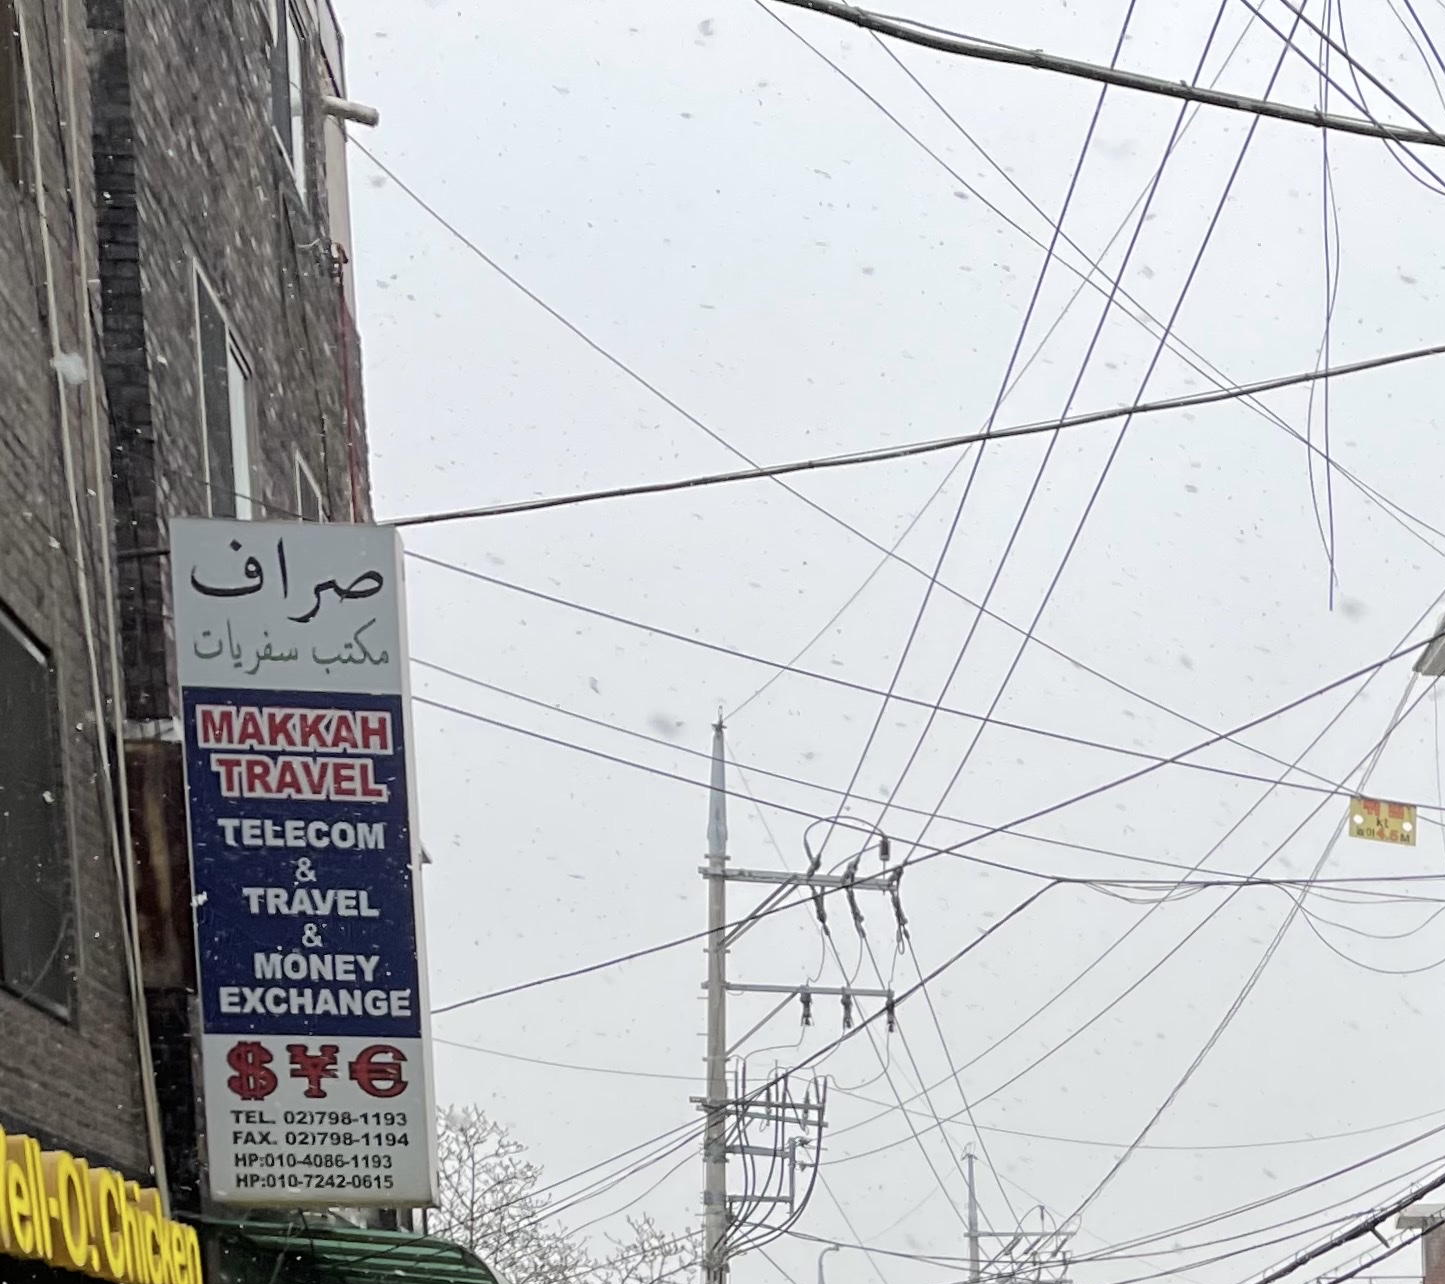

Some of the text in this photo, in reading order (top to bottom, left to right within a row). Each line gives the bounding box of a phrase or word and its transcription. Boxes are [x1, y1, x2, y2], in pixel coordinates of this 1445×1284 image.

[190, 537, 385, 623] صراف
[193, 617, 390, 676] مكتب سفريات
[199, 705, 391, 753] MAKKAH
[215, 755, 386, 800] TRAVEL
[217, 818, 386, 850] TELECOM
[295, 857, 317, 882] &
[242, 887, 380, 918] TRAVEL
[301, 923, 323, 948] &
[253, 951, 381, 982] MONEY
[219, 986, 412, 1017] EXCHANGE
[230, 1110, 408, 1127] TEL. 02)798-1193
[232, 1131, 410, 1147] FAX. 02)798-1194
[234, 1152, 393, 1169] HP:010-4086-1193
[235, 1173, 395, 1190] HP:010-7242-0615
